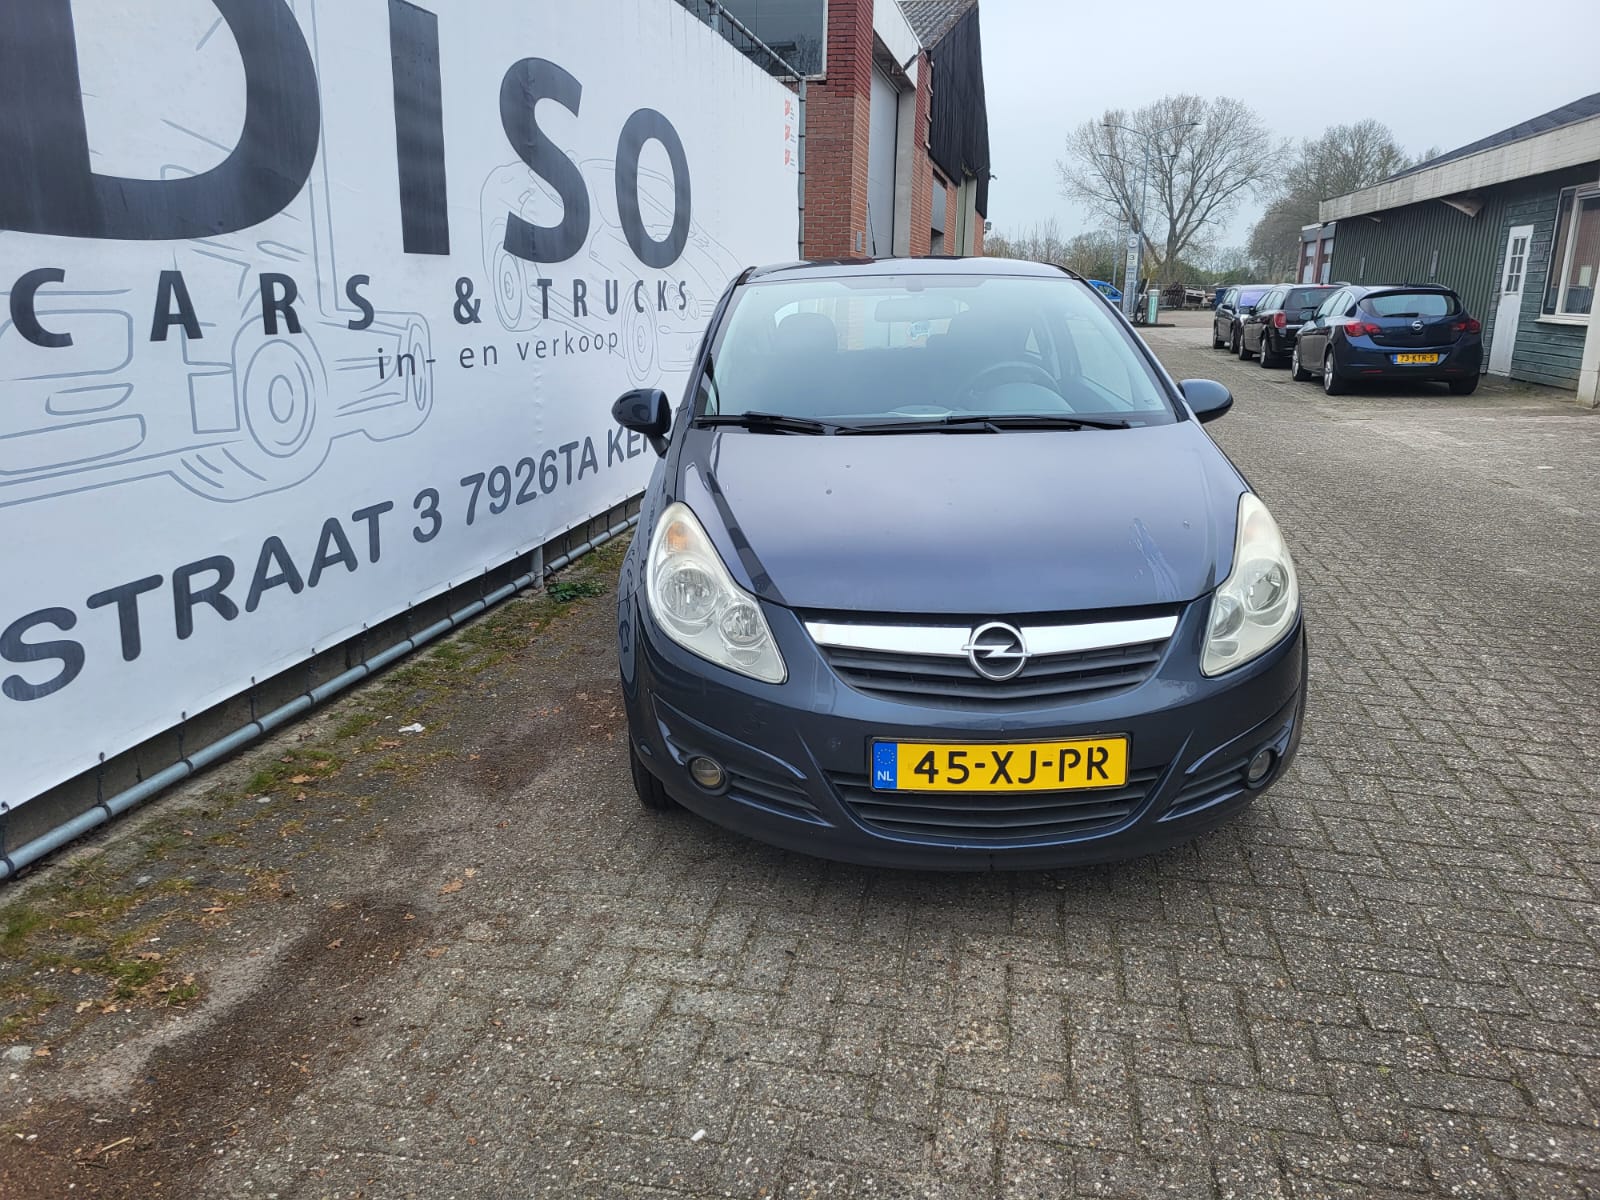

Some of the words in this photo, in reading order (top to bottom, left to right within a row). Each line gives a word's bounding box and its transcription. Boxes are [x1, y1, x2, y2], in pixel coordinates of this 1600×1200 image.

[0, 0, 692, 269] DISO
[9, 267, 376, 348] CARS
[453, 276, 482, 325] &
[536, 278, 687, 320] TRUCKS
[377, 347, 437, 380] in-
[459, 345, 498, 369] en
[516, 331, 618, 361] verkoop
[0, 500, 394, 701] STRAAT
[413, 487, 443, 543] 3
[460, 436, 599, 525] 7926TA
[877, 770, 894, 782] NL
[914, 747, 1109, 784] 45-XJ-PR
